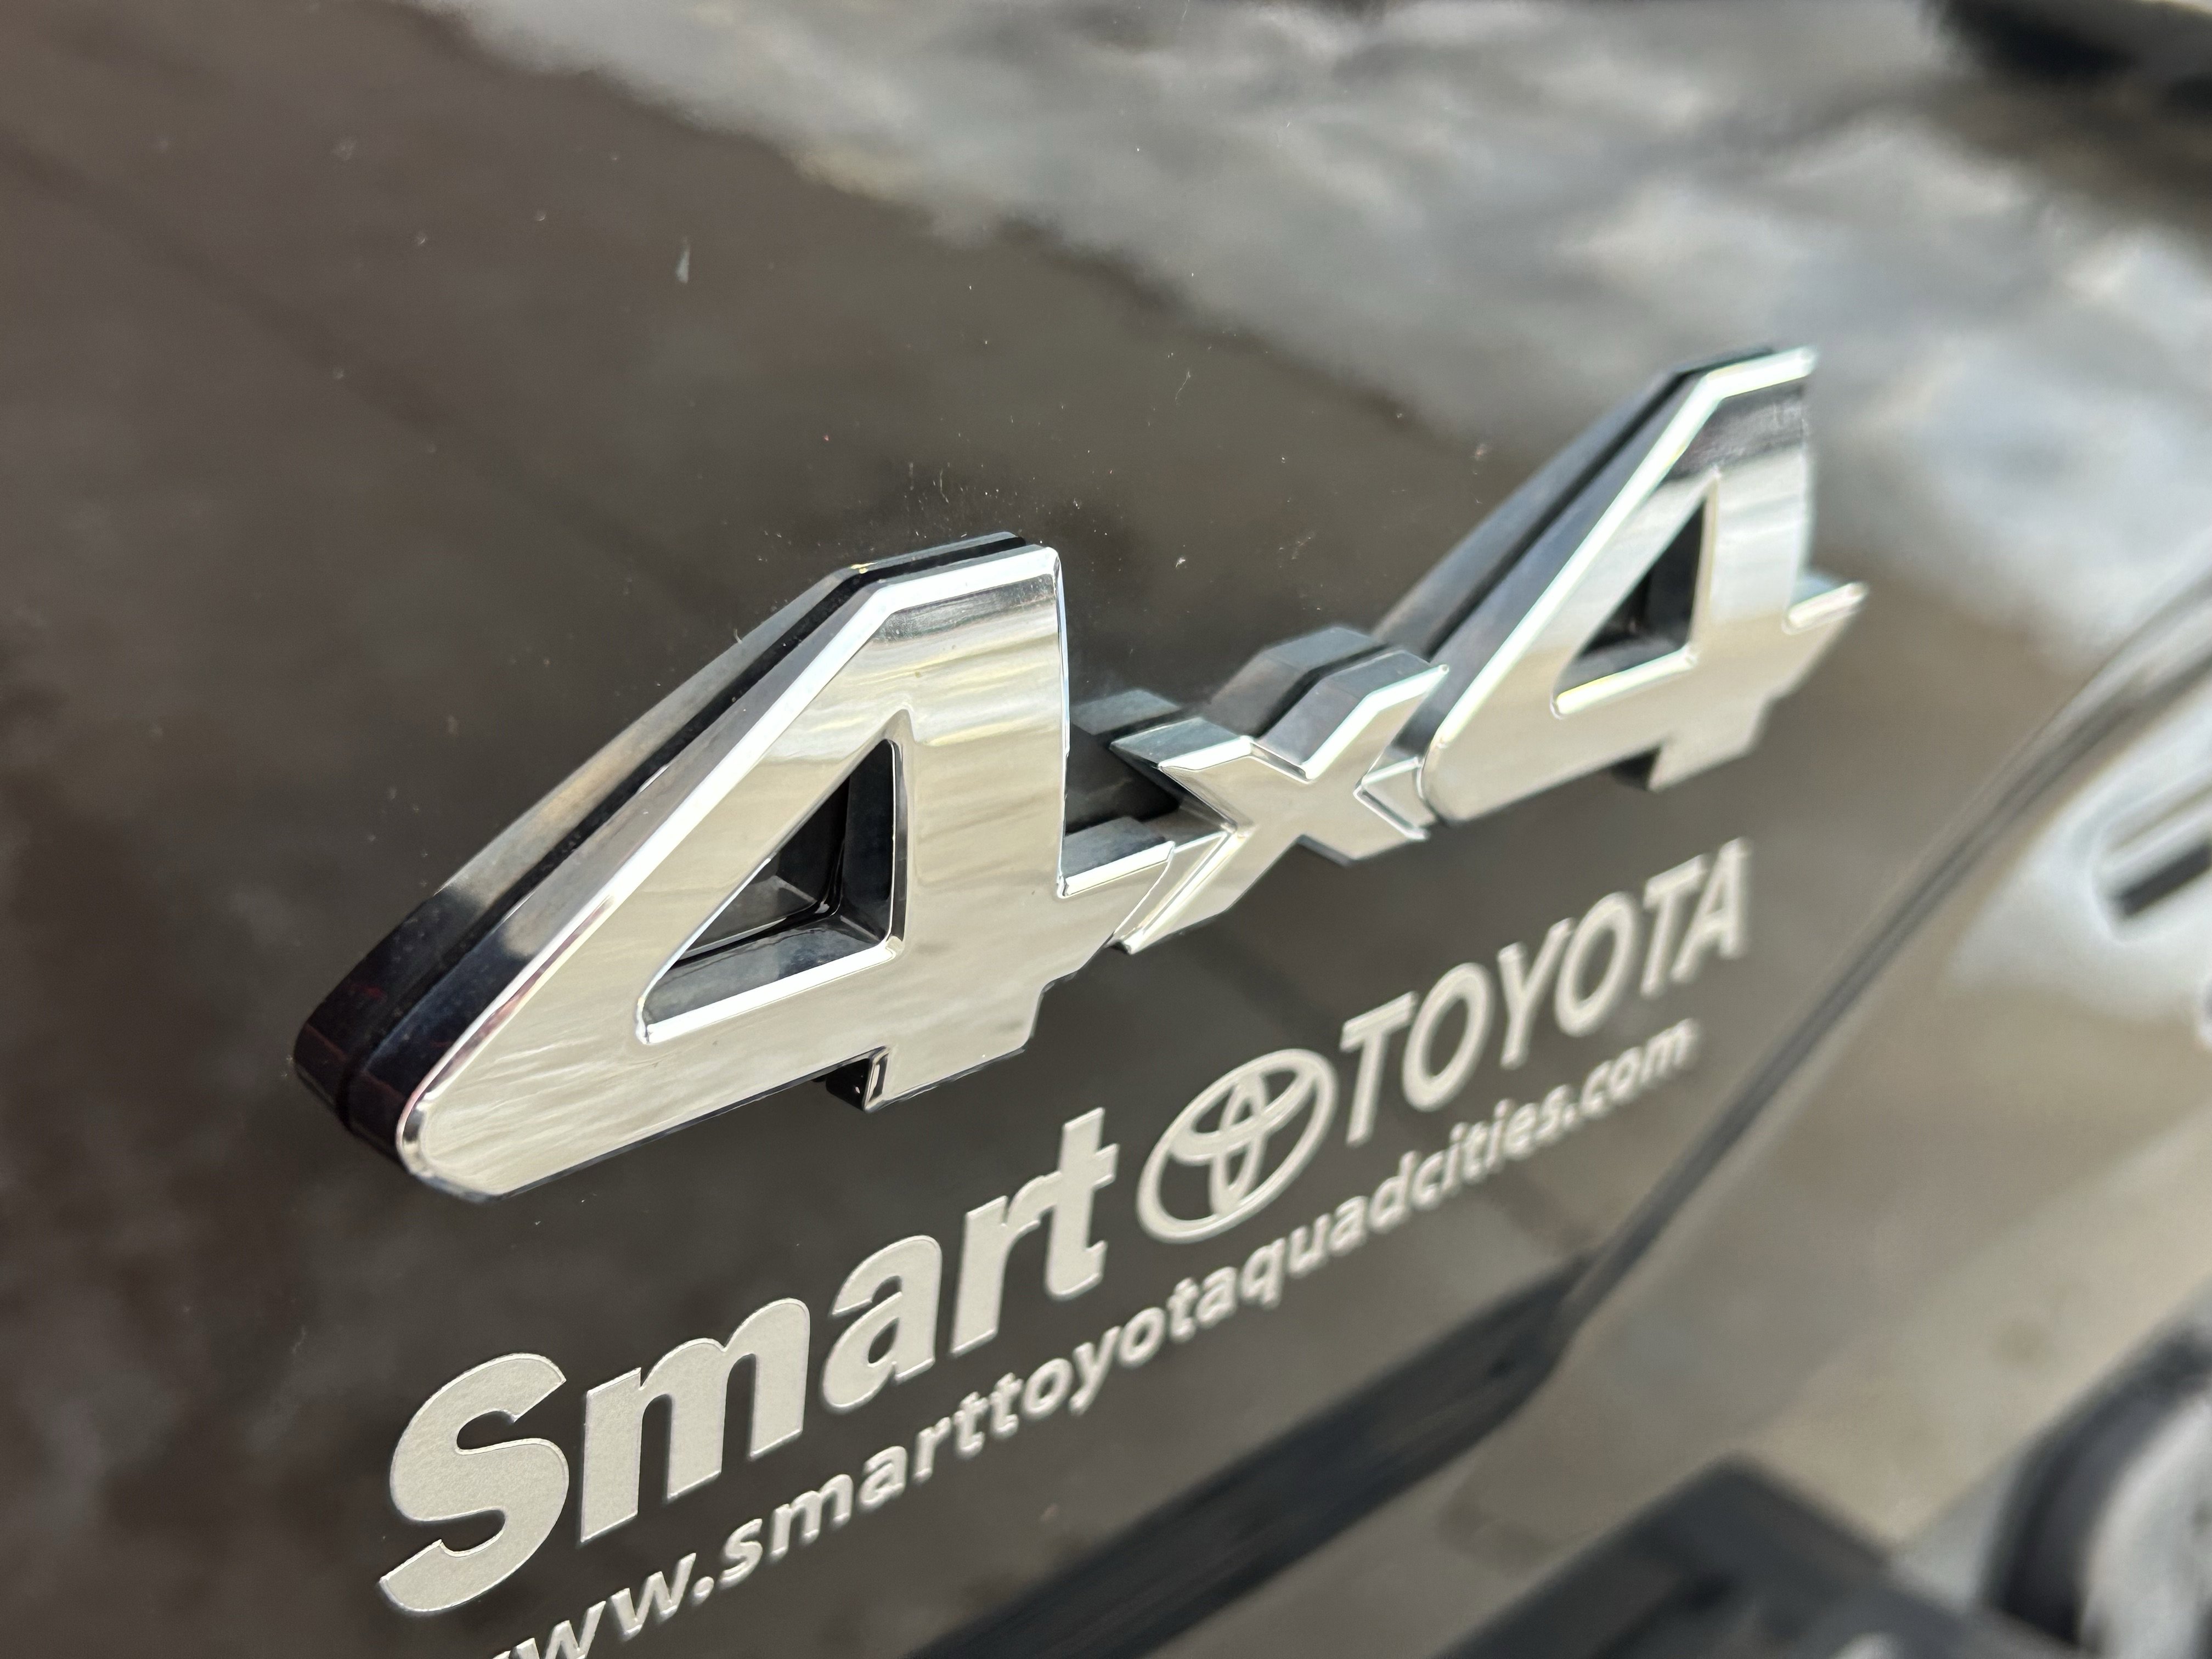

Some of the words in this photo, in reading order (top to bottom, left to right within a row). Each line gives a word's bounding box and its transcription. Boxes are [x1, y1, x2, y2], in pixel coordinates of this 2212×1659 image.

[379, 1105, 1120, 1615] Smart
[1340, 837, 1751, 1147] TOYOTA
[492, 1018, 1698, 1659] ww.smarttoyotaquadcities.com
